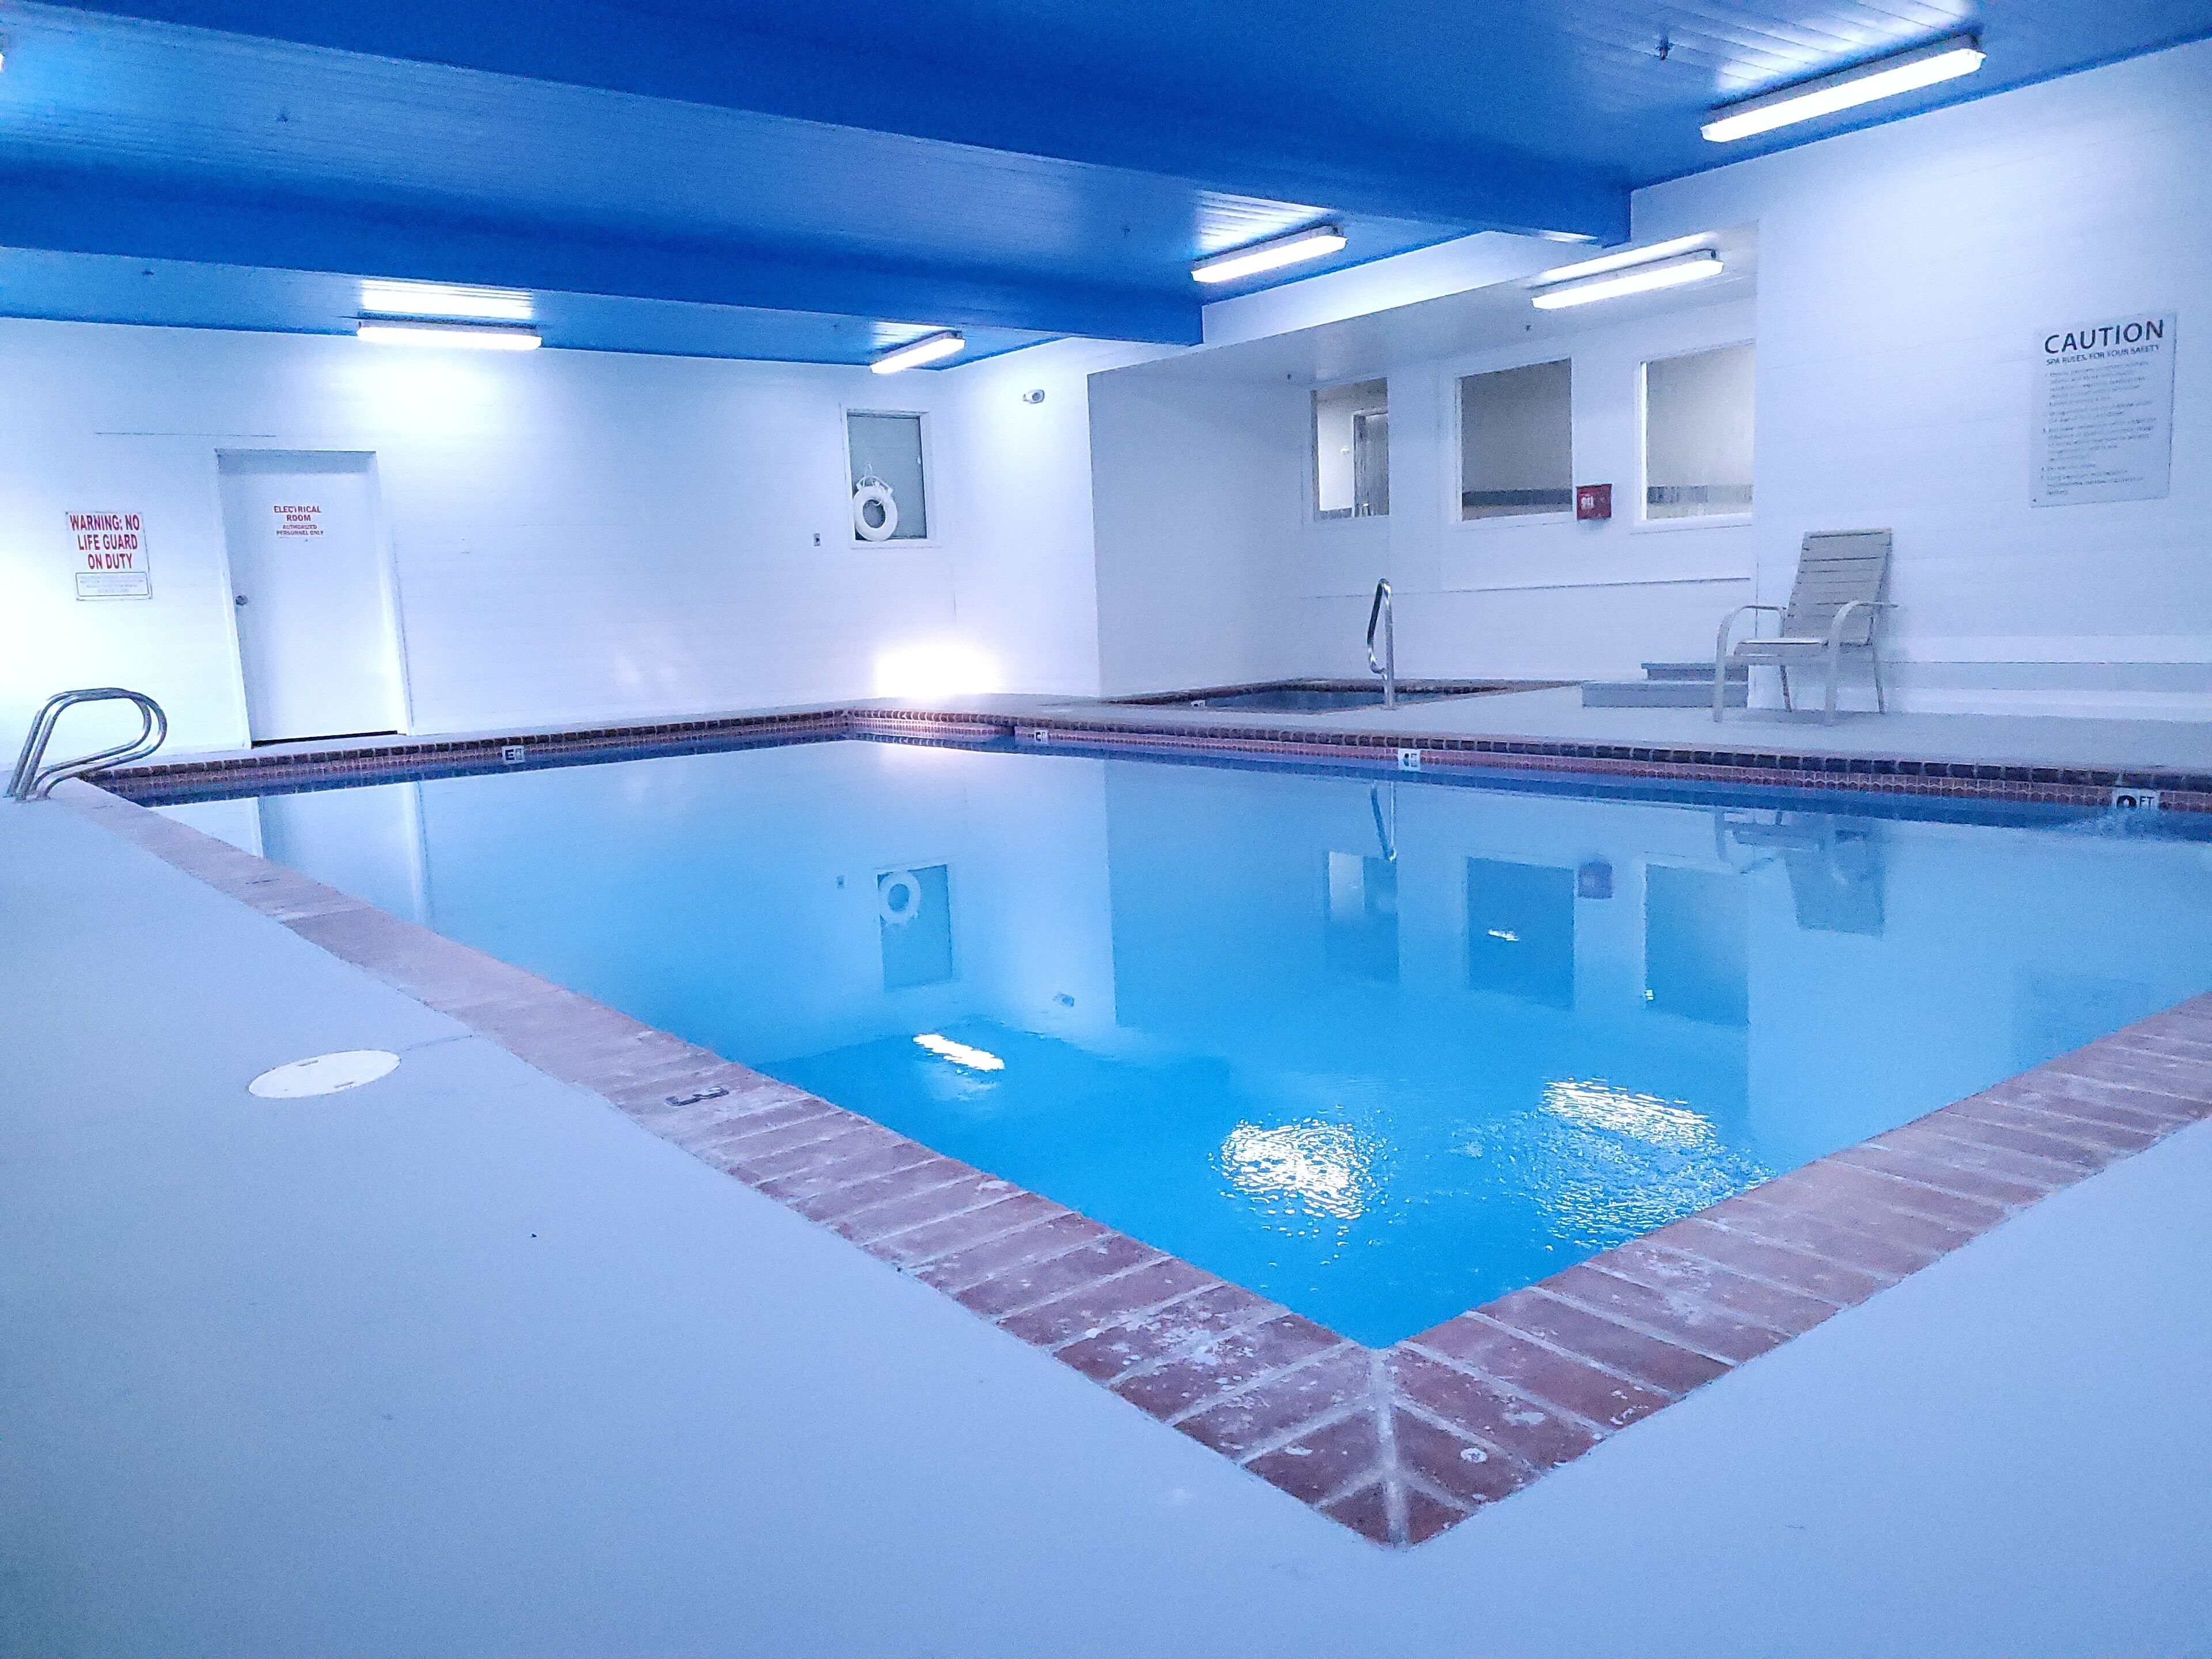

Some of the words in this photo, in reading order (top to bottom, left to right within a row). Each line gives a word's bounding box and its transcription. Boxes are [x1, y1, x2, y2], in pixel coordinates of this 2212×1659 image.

[2044, 319, 2164, 354] CAUTION
[2046, 357, 2059, 366] SPA
[2089, 351, 2105, 359] FOR
[2107, 347, 2129, 357] YOUR
[2131, 344, 2159, 354] SAFETY
[70, 514, 123, 531] WARNING:
[124, 514, 140, 531] NO
[77, 534, 101, 551] LIFE
[103, 533, 138, 550] GUARD
[88, 553, 104, 570] ON
[105, 553, 132, 569] DUTY
